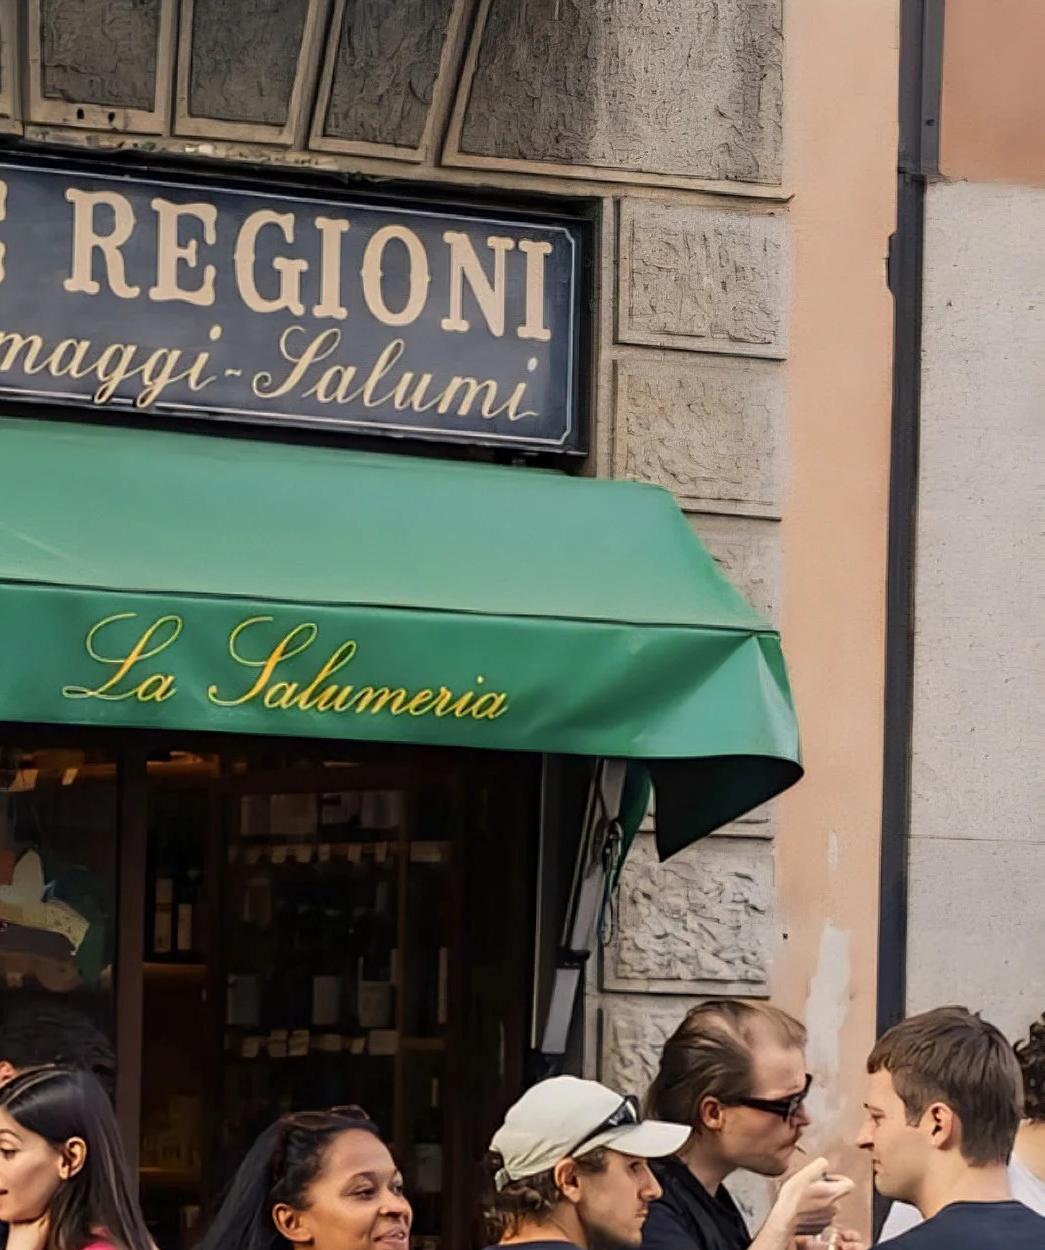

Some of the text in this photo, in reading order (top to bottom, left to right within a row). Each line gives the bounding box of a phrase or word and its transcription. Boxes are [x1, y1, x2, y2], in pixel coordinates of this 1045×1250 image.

[63, 188, 553, 341] REGIONI
[252, 325, 540, 422] Salumi
[62, 613, 509, 719] La Salumeria
